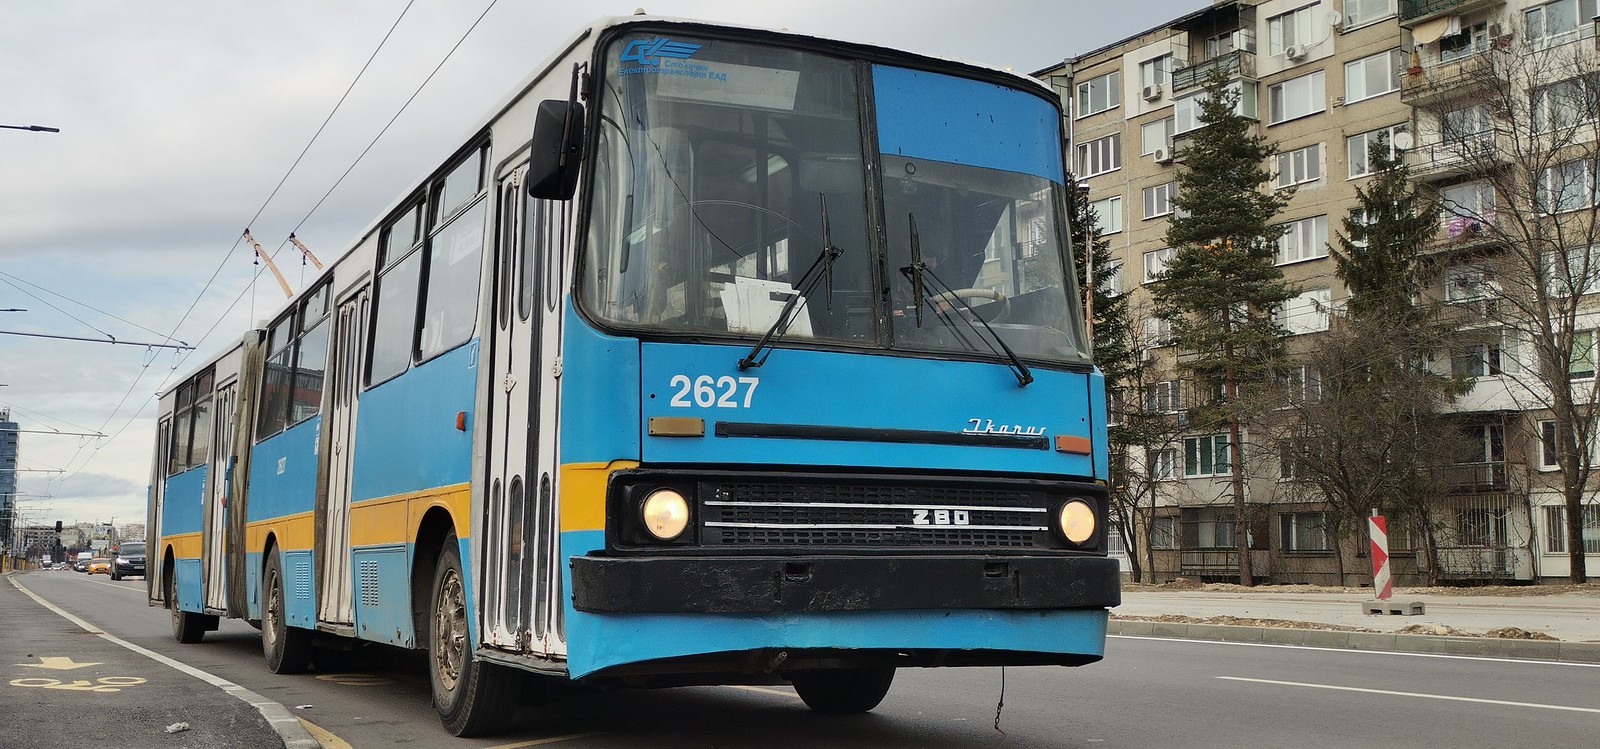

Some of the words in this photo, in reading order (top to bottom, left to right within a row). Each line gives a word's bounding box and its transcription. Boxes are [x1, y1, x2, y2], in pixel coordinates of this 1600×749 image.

[708, 72, 728, 82] ЕАД
[670, 374, 760, 408] 2627
[962, 418, 1047, 436] Ikarus
